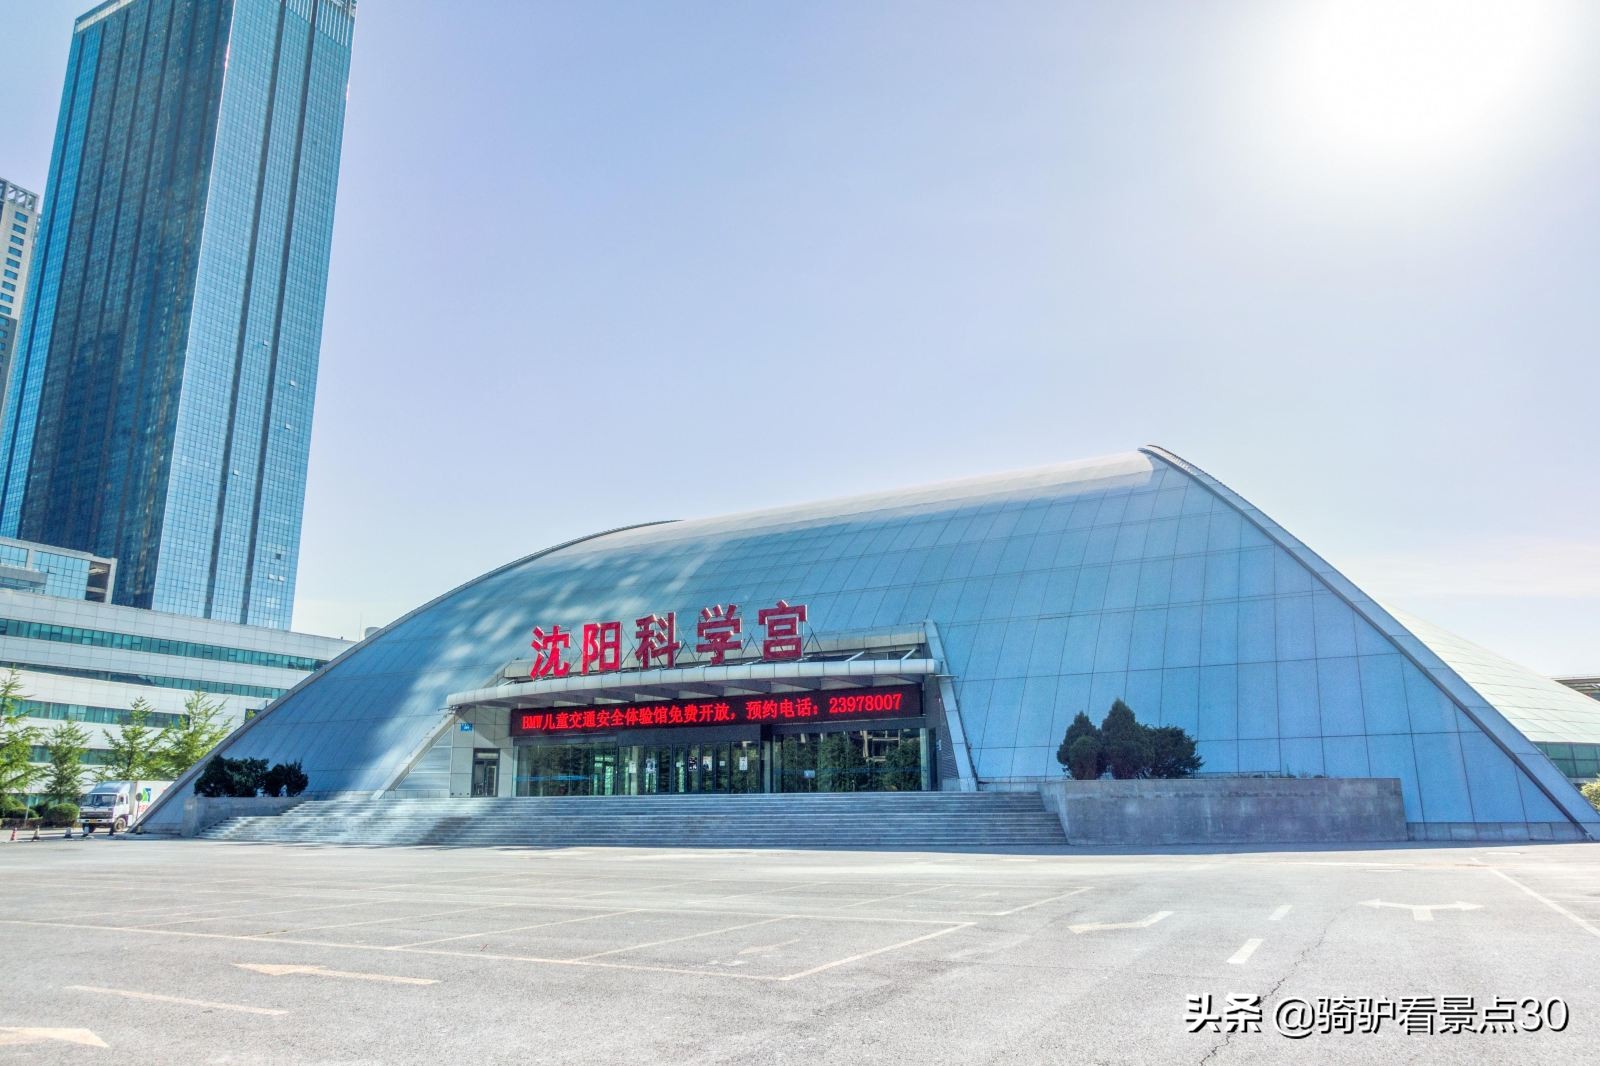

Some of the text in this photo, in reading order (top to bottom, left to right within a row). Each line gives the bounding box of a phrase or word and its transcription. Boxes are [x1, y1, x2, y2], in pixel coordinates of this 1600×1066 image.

[530, 600, 808, 680] 沈阳科学宫
